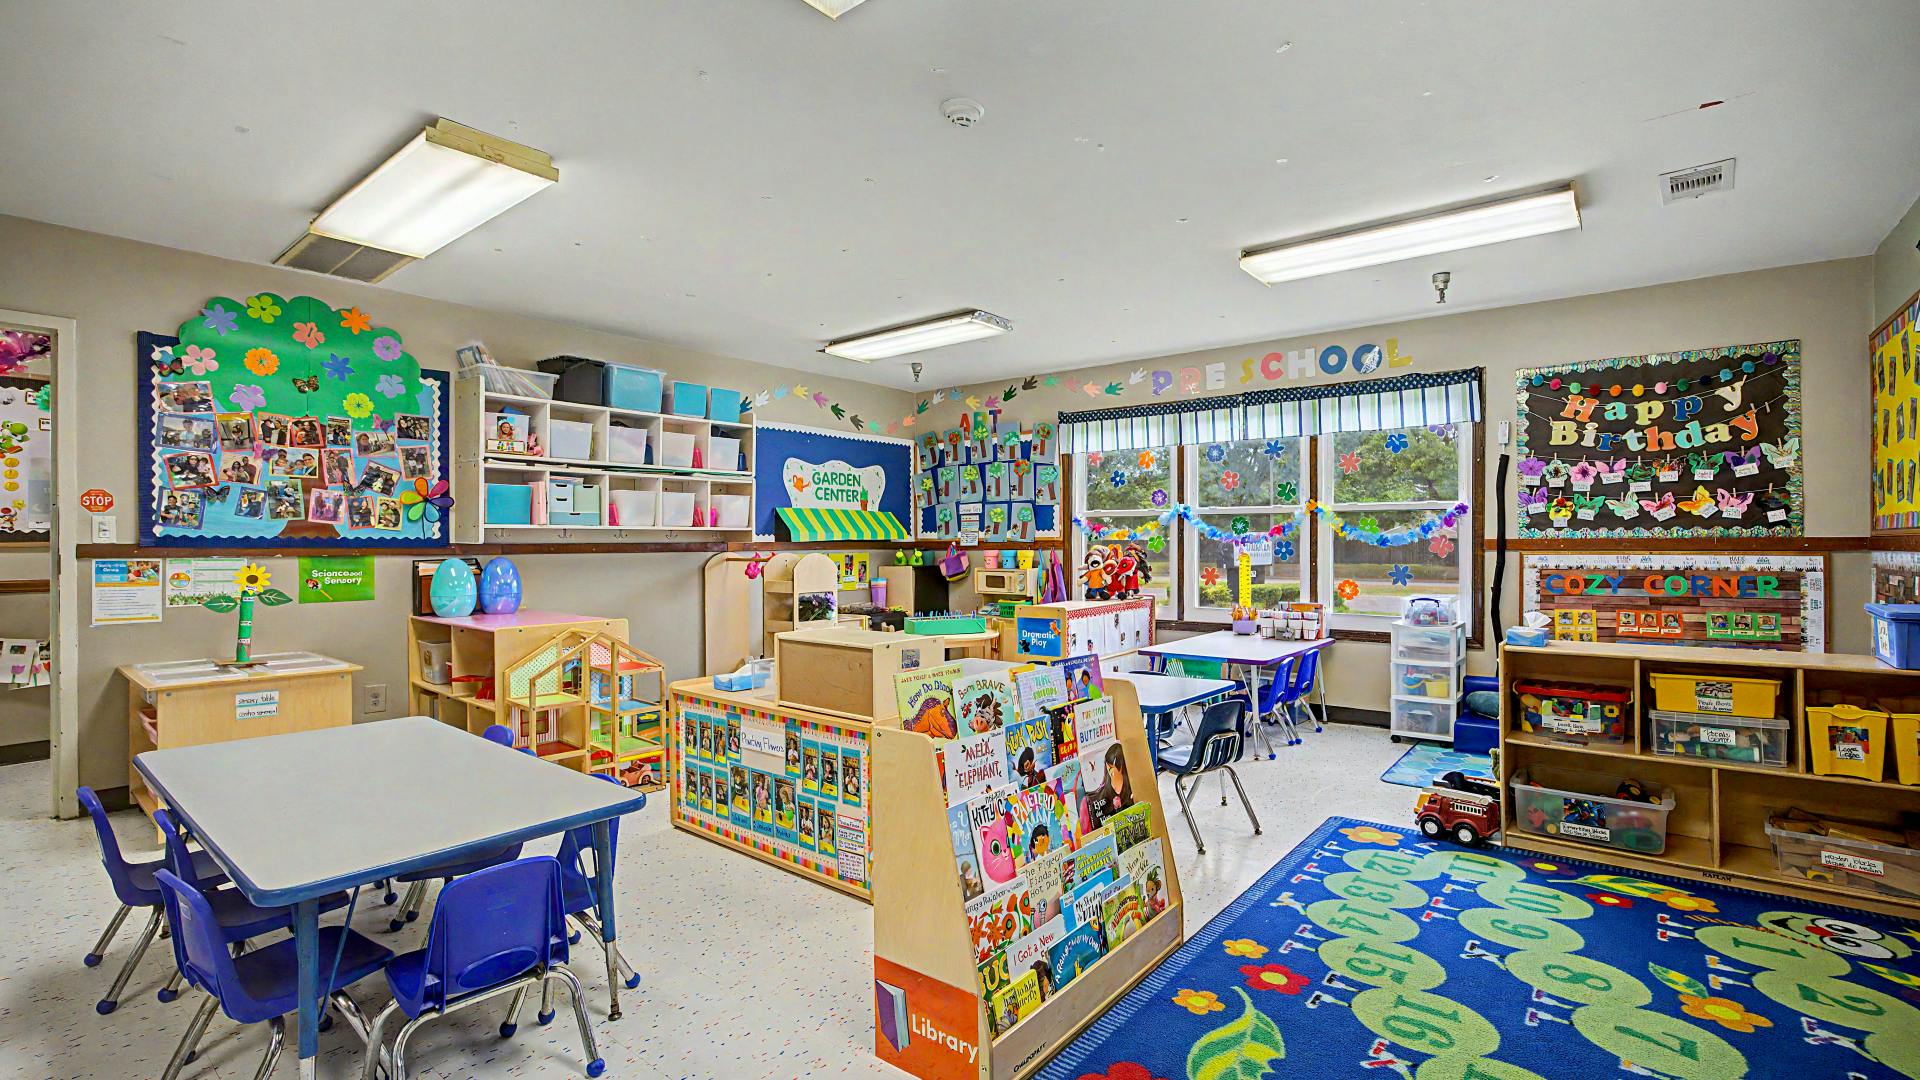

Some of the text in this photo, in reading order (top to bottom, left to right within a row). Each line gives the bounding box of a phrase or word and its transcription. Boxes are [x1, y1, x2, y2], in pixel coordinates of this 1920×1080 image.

[1560, 381, 1744, 425] Happy
[1549, 410, 1758, 451] Birthday
[812, 472, 861, 487] GARDEN
[82, 496, 113, 506] STOP
[815, 487, 859, 502] CENTER
[324, 577, 362, 585] Sensory
[1545, 573, 1781, 597] COZY CORNER
[1022, 630, 1056, 639] Dramatic
[1031, 638, 1047, 648] Play
[976, 680, 1005, 693] BRAVE
[1080, 722, 1112, 743] BUTTERFLY
[966, 741, 990, 762] MELA
[958, 760, 999, 788] ELEPHANT
[1362, 852, 1417, 876] 12
[1448, 854, 1500, 878] 11
[1343, 874, 1401, 904] 13
[1504, 885, 1565, 914] 10
[1320, 902, 1392, 936] 14
[1490, 918, 1549, 940] 9
[1018, 946, 1032, 962] Got
[1040, 932, 1054, 946] New
[1732, 936, 1806, 959] 1
[1346, 942, 1416, 985] 15
[1542, 963, 1612, 991] 8
[1797, 982, 1887, 1016] 2
[1382, 994, 1461, 1048] 16
[912, 1014, 978, 1064] Library
[1614, 1025, 1701, 1062] 7
